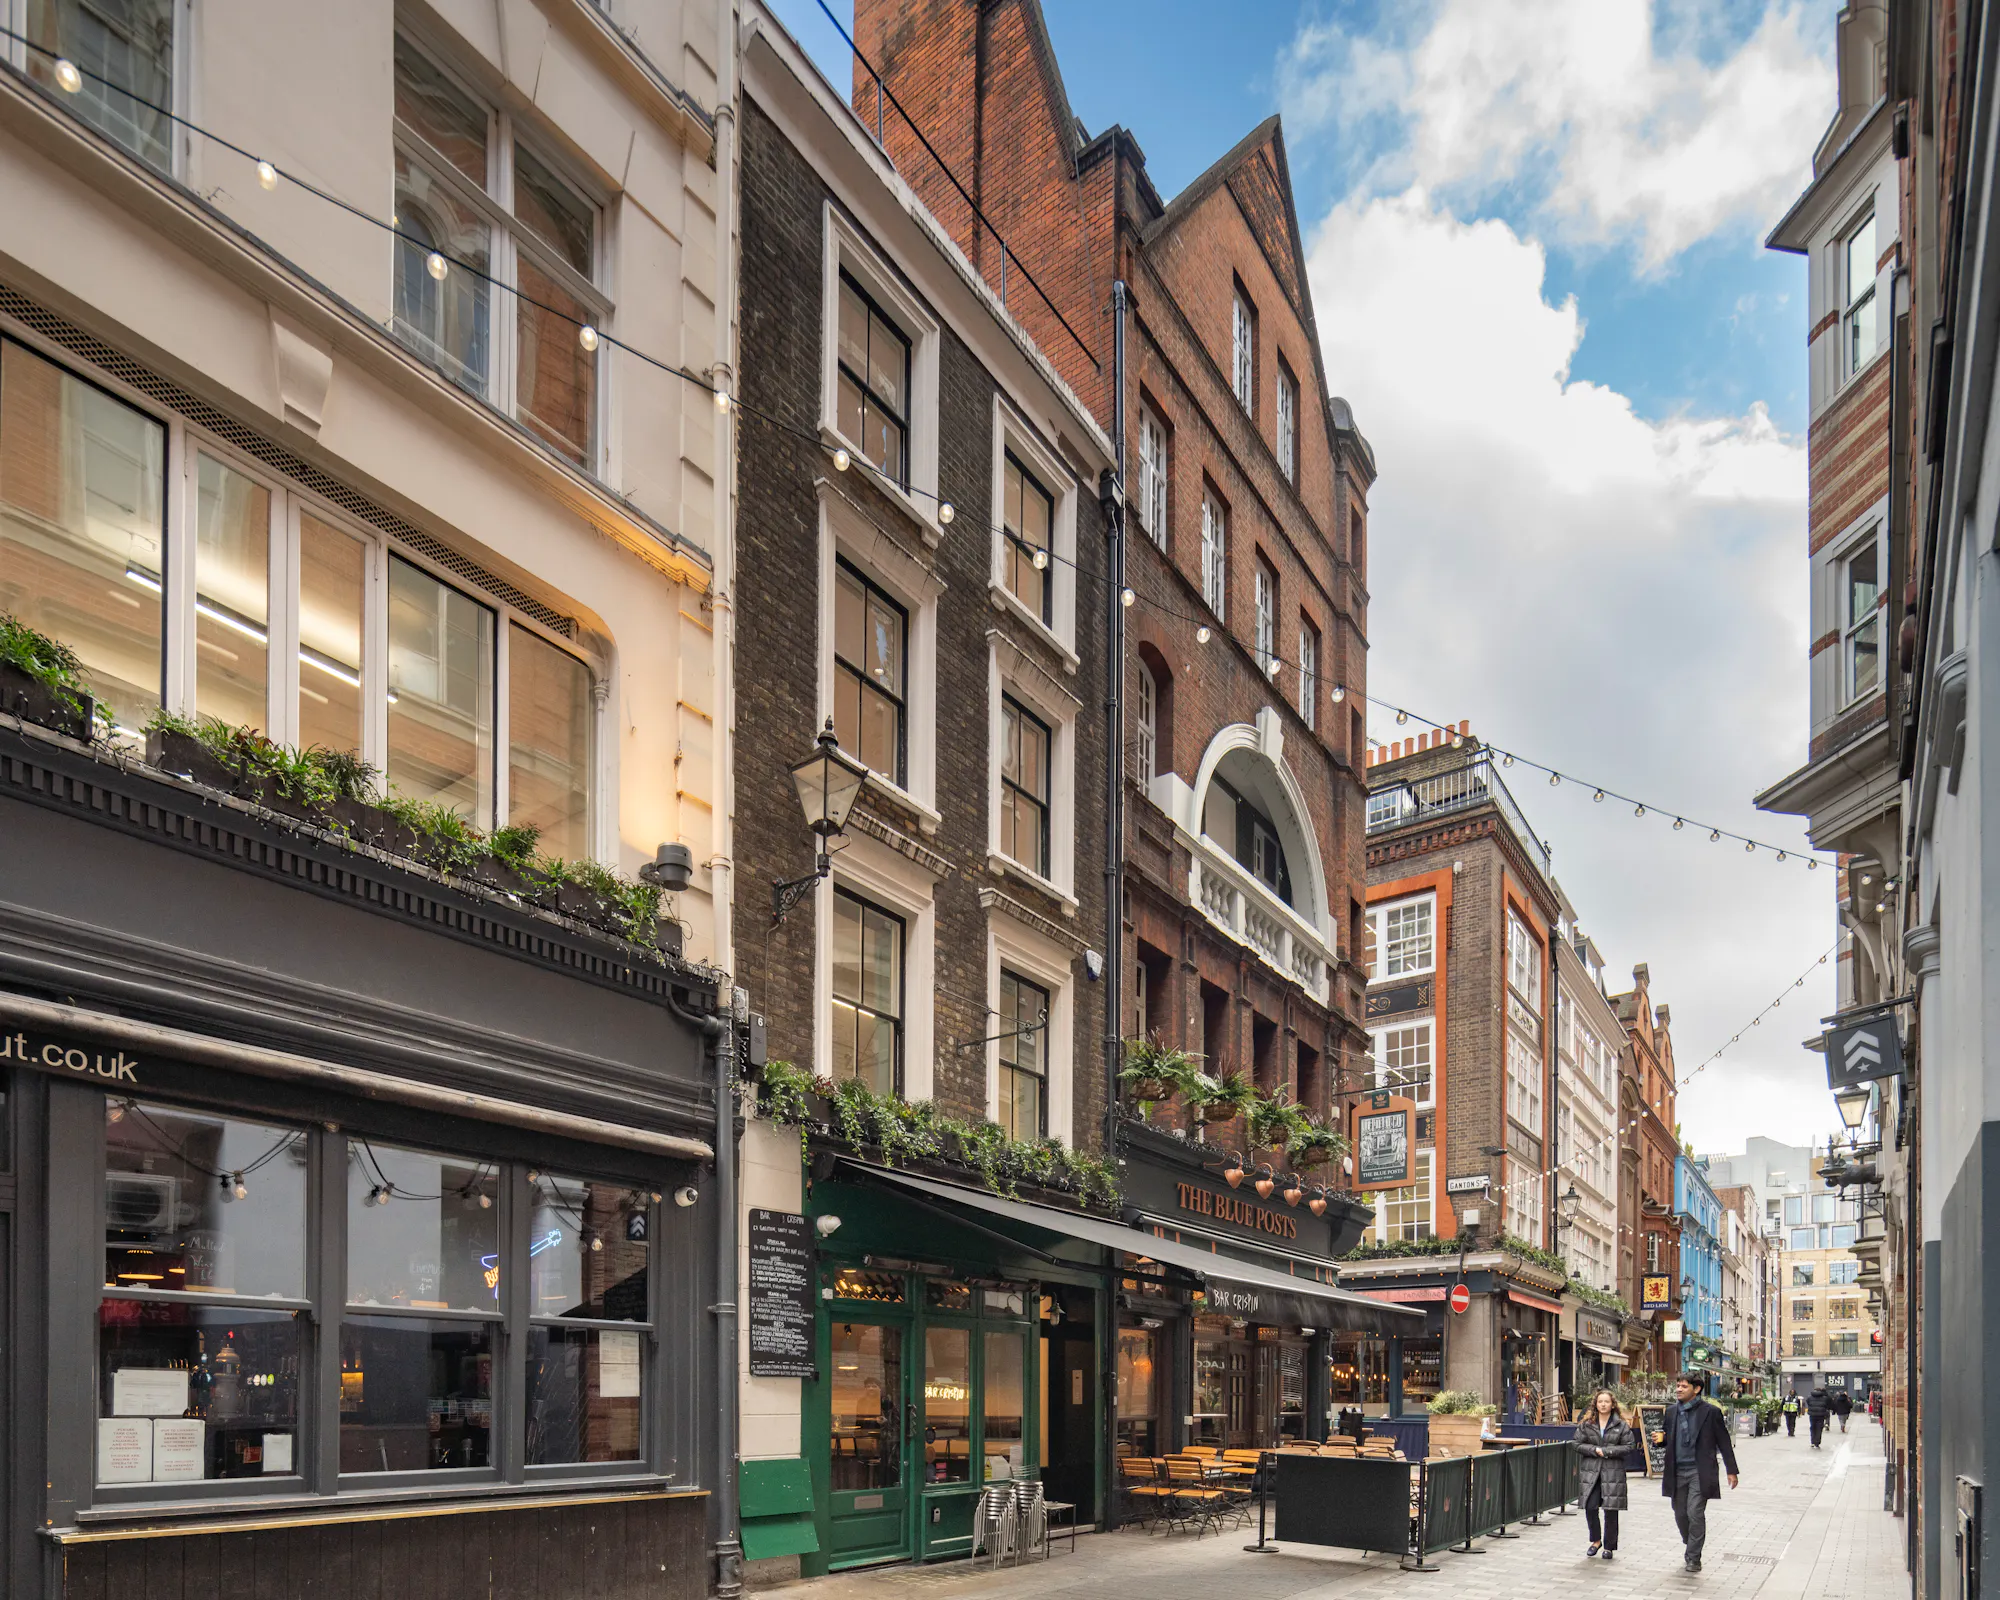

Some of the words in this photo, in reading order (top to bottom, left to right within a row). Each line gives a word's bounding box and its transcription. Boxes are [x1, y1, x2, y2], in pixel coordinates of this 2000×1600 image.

[757, 1017, 764, 1027] 6
[1450, 1181, 1475, 1190] GANTON
[759, 1210, 771, 1221] BAR
[1177, 1182, 1213, 1216] THE
[1215, 1193, 1254, 1228] BLUE
[1256, 1207, 1297, 1239] POSTS
[1213, 1288, 1230, 1308] BAR
[1232, 1293, 1259, 1314] CRISPIN
[939, 1386, 965, 1401] CRISPIN
